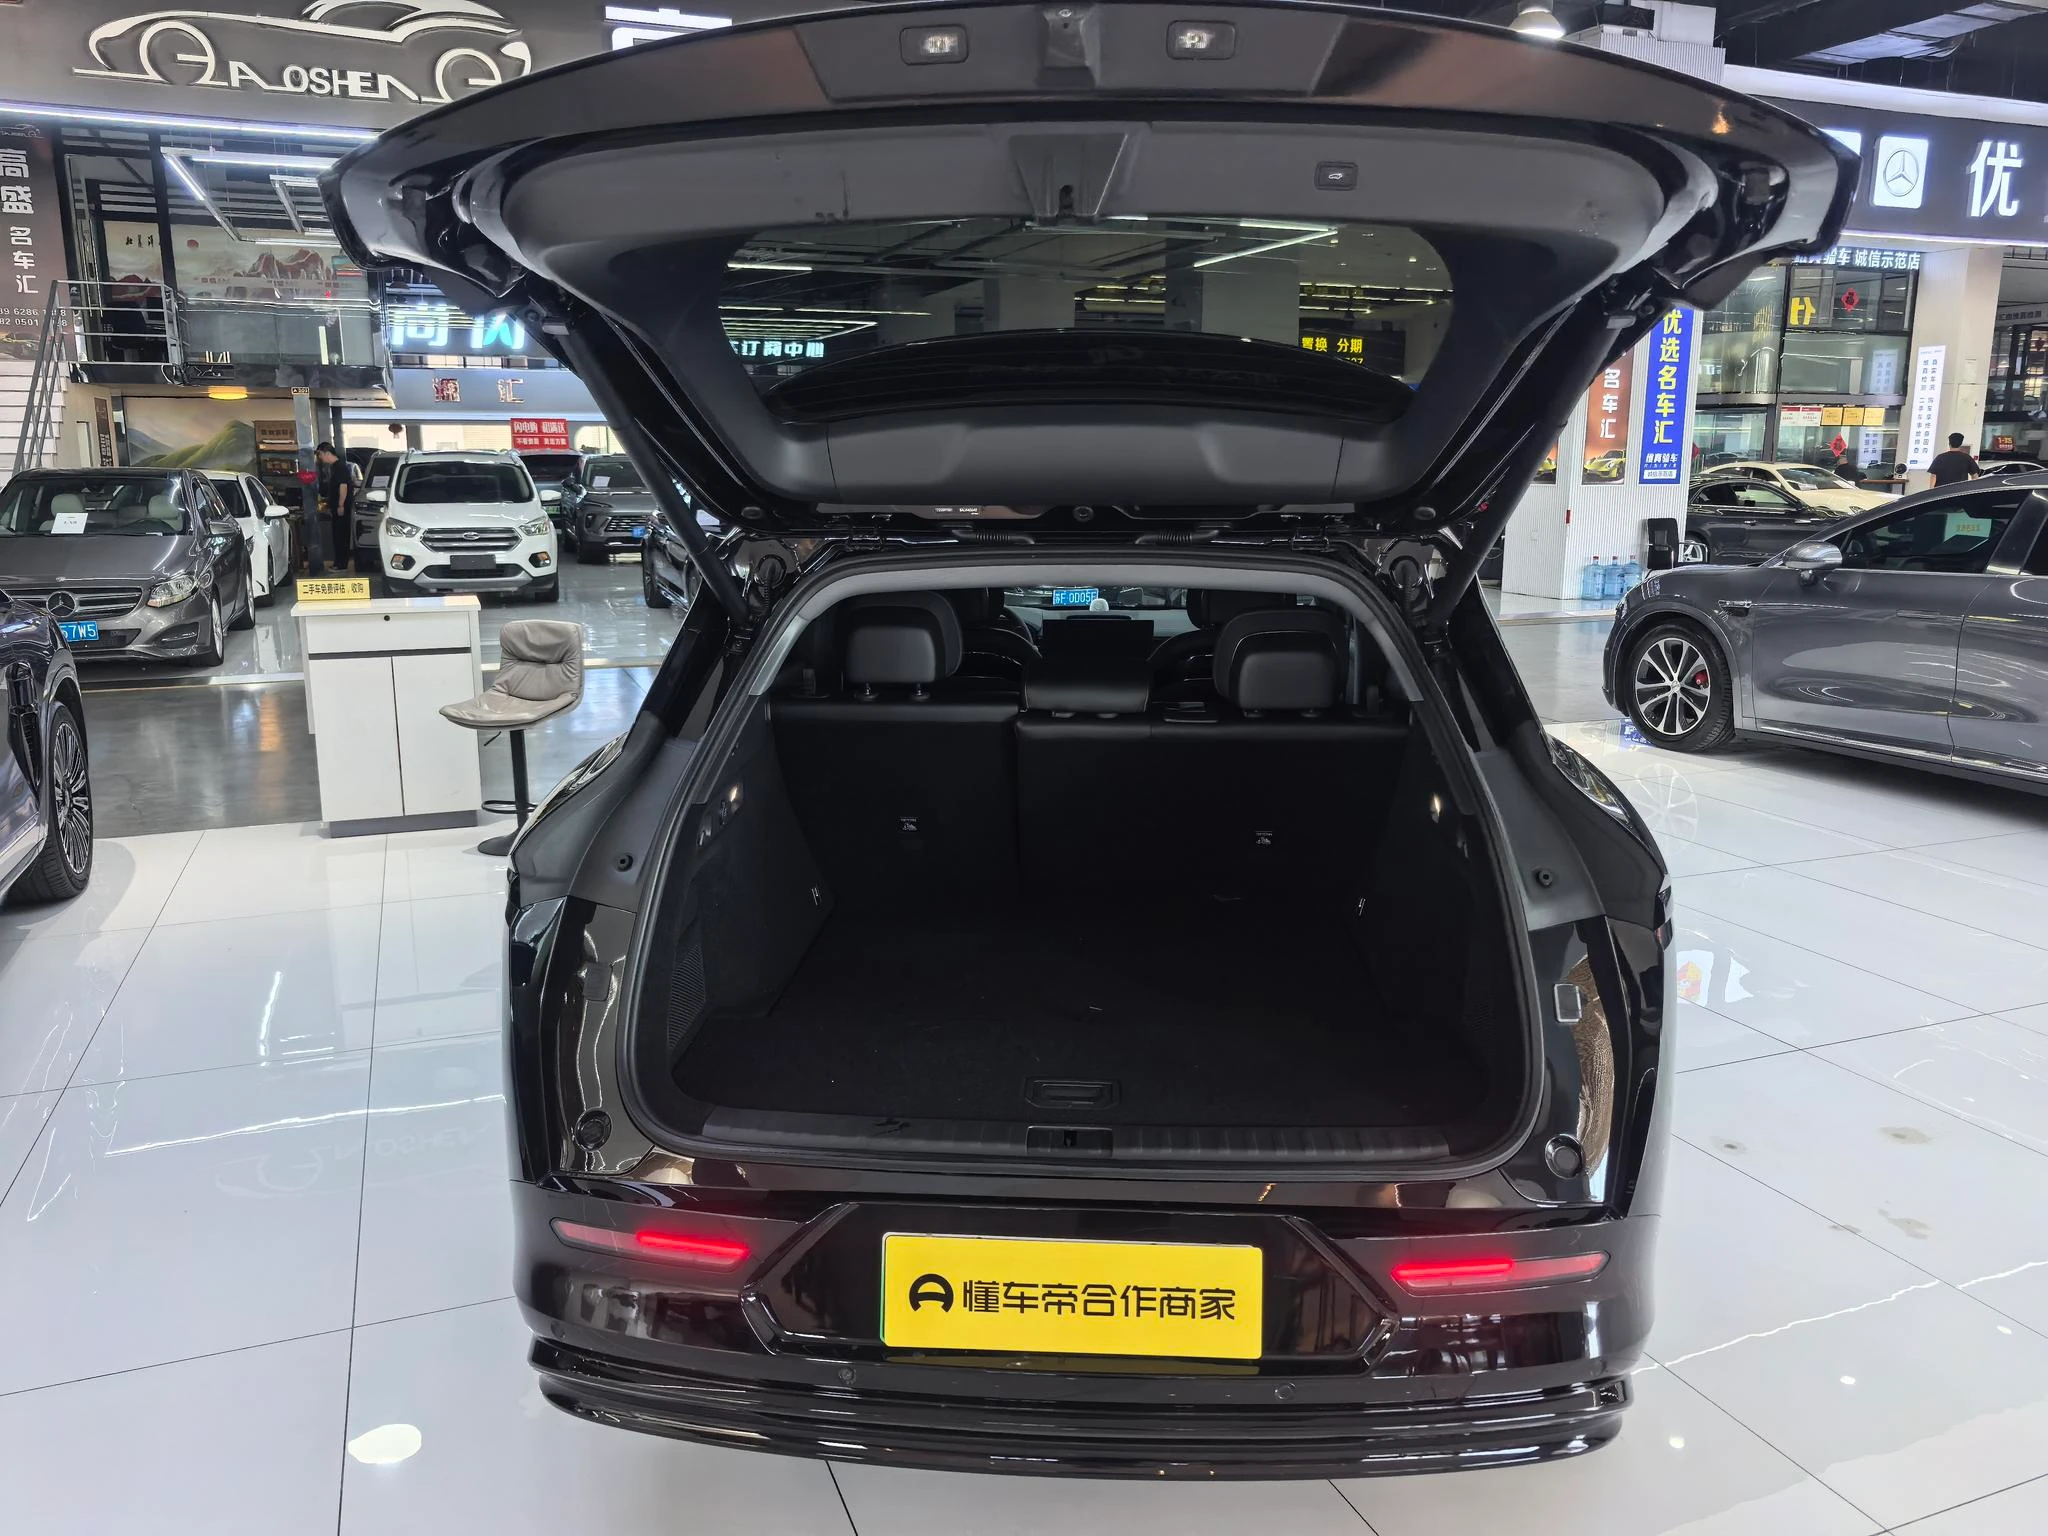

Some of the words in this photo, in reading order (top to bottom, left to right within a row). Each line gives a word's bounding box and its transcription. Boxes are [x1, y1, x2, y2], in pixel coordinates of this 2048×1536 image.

[1855, 249, 1920, 270] 诚信示范店
[15, 318, 38, 326] 0501
[1337, 338, 1363, 353] 分期
[1653, 309, 1682, 445] 优选名车汇
